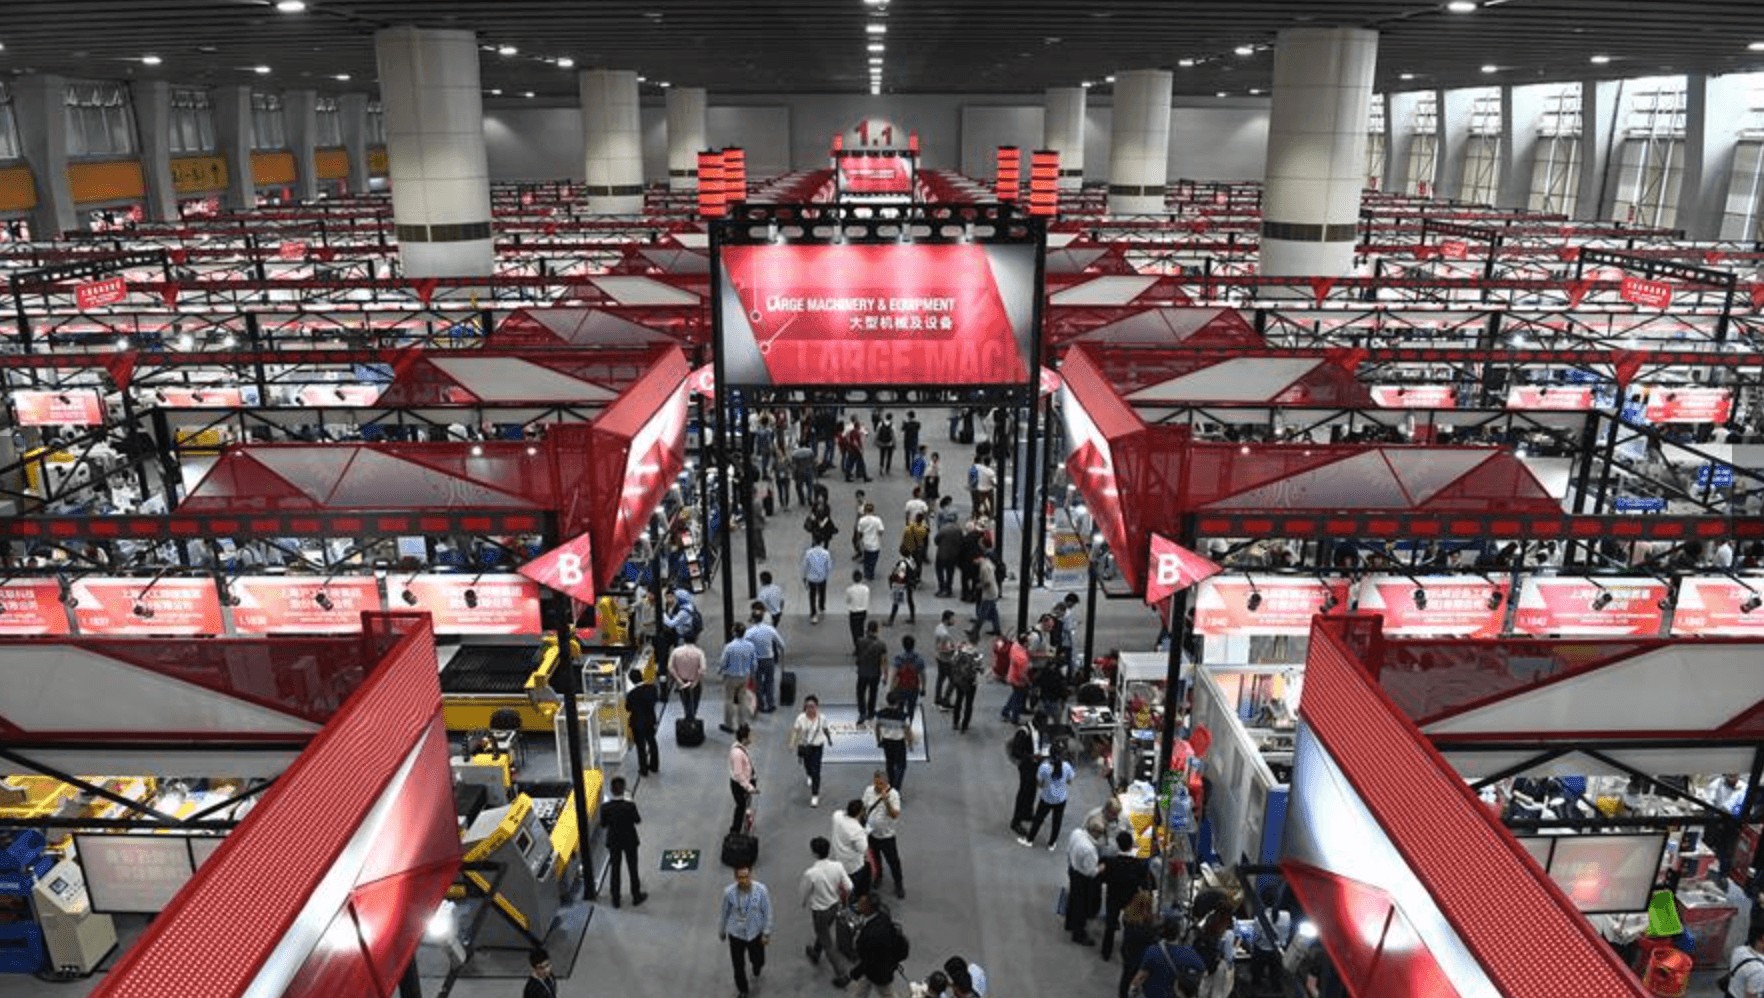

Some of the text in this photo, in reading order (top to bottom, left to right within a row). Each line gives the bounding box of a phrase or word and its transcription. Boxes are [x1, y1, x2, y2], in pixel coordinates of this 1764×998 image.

[854, 120, 892, 146] 1.1
[766, 296, 955, 312] LARGE MACHINERY & EQUIPMENT
[849, 315, 953, 331] 大型机械及设备
[558, 553, 583, 586] B
[1156, 553, 1180, 585] B
